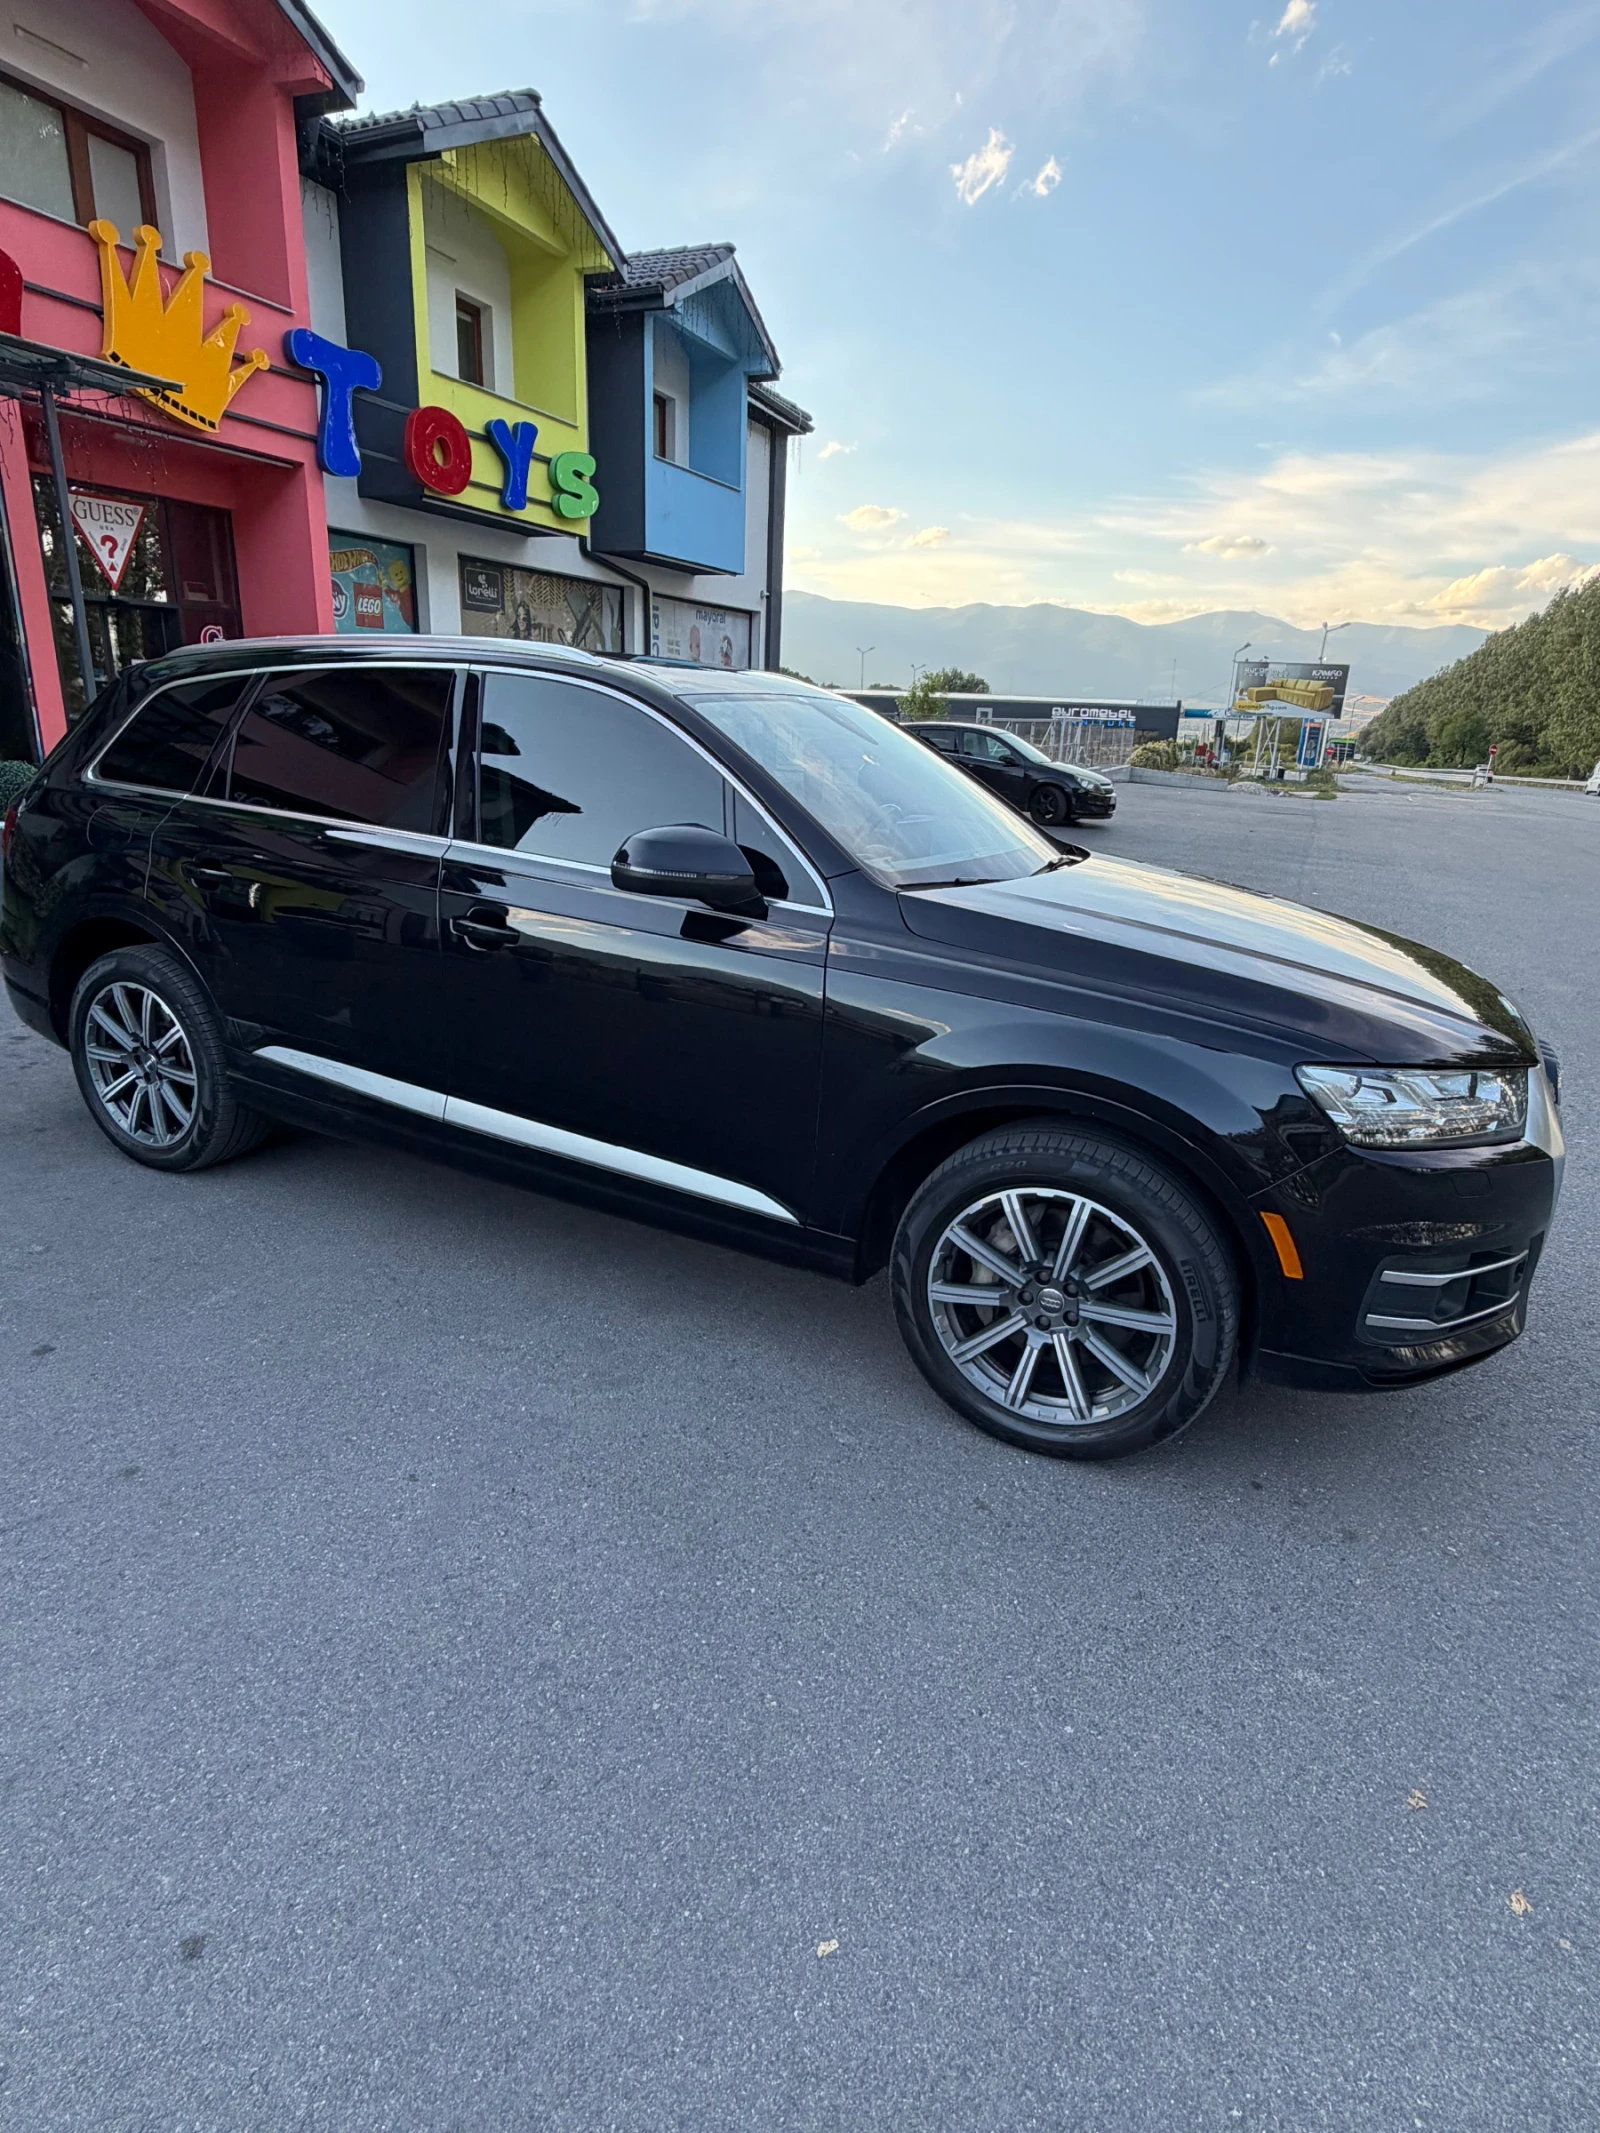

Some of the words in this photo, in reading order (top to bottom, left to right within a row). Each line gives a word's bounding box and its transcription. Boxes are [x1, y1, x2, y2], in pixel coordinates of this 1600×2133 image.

[283, 328, 600, 519] TOYS
[73, 500, 135, 527] GUESS
[357, 597, 381, 615] LEGO
[695, 609, 727, 626] mayoral
[1051, 706, 1136, 719] euromebel
[1180, 1258, 1210, 1324] PIRELLI
